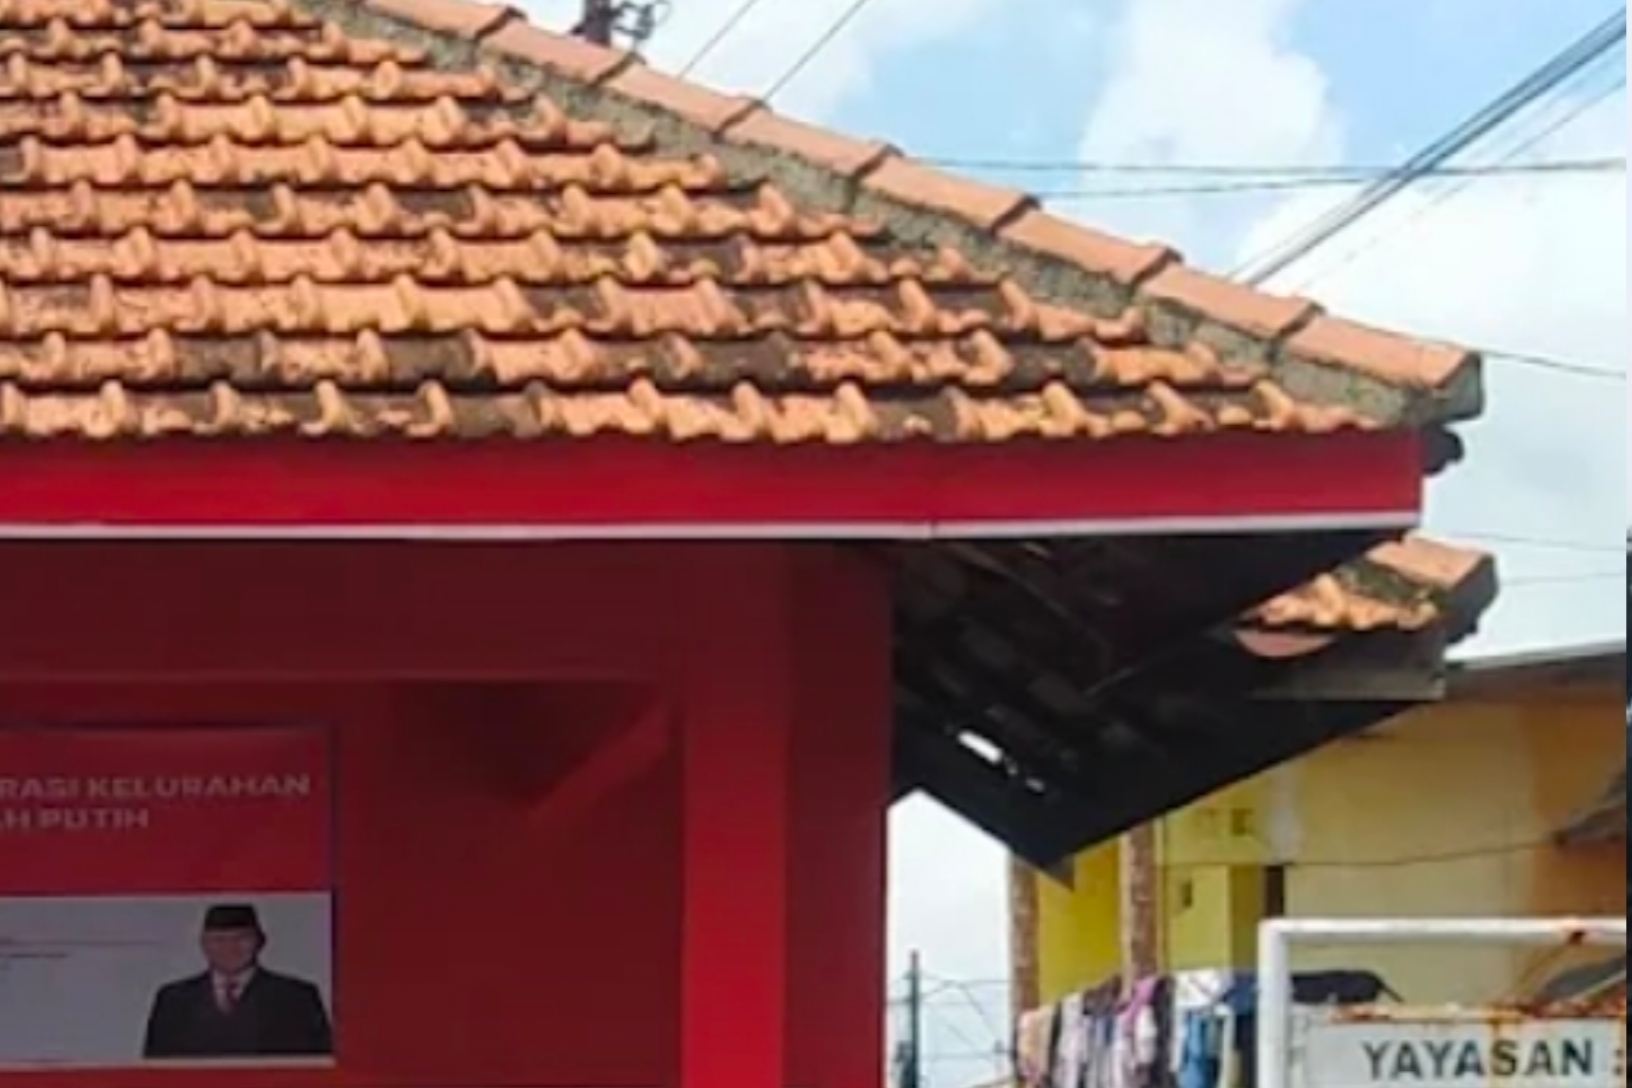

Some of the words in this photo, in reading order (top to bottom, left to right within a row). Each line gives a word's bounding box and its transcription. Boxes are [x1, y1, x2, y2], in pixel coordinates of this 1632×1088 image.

[87, 774, 310, 799] KELURAHAN
[39, 807, 150, 830] PUTIH
[1362, 1039, 1594, 1080] YAYASAN
